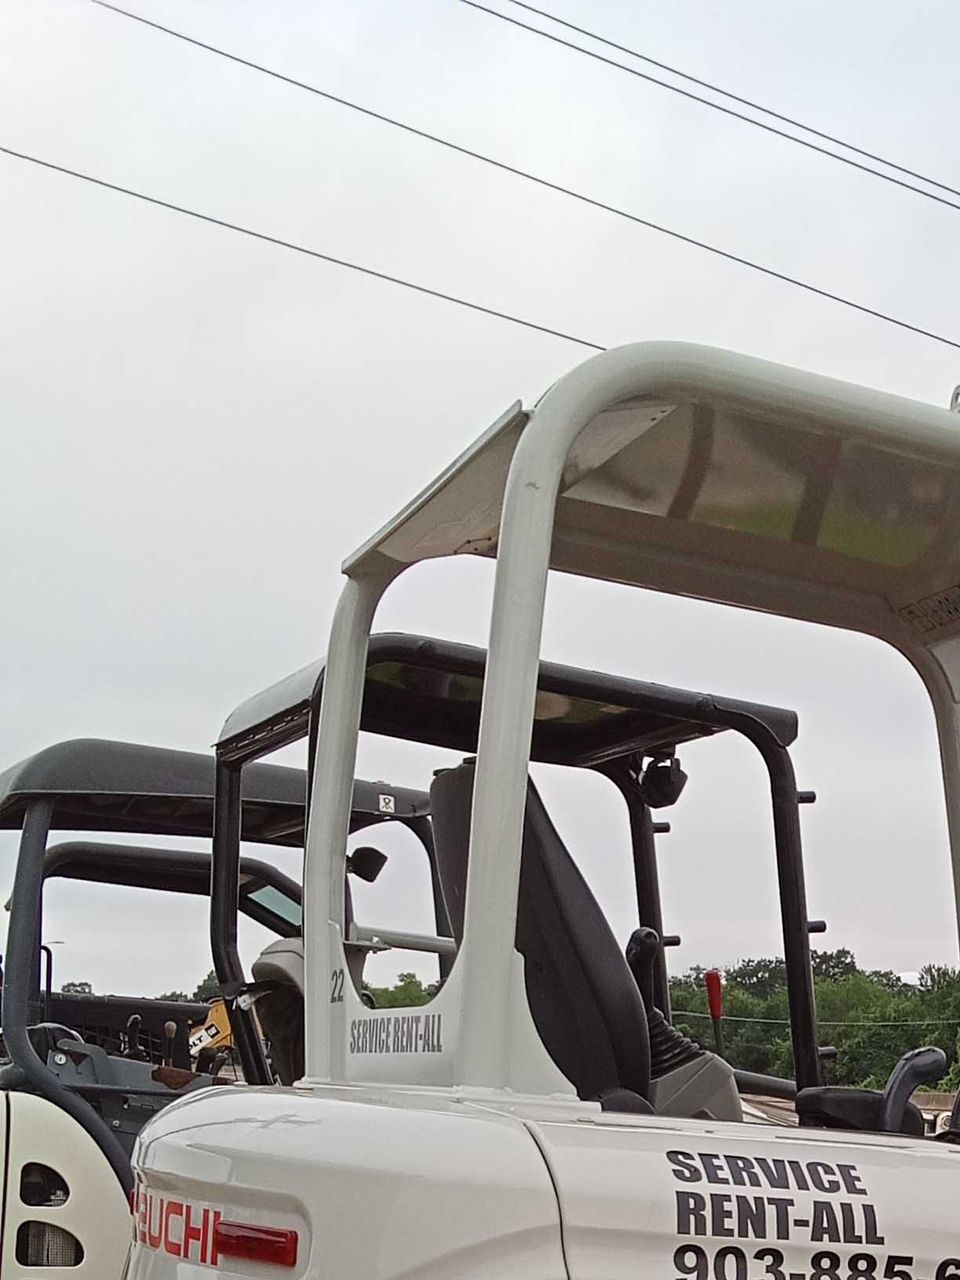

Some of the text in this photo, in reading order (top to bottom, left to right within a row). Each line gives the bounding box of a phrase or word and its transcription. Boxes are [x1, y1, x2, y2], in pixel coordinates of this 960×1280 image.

[330, 968, 345, 1004] 22
[350, 1013, 443, 1054] SERVICE RENT-ALL
[666, 1151, 867, 1196] SERVICE
[676, 1191, 885, 1246] RENT-ALL
